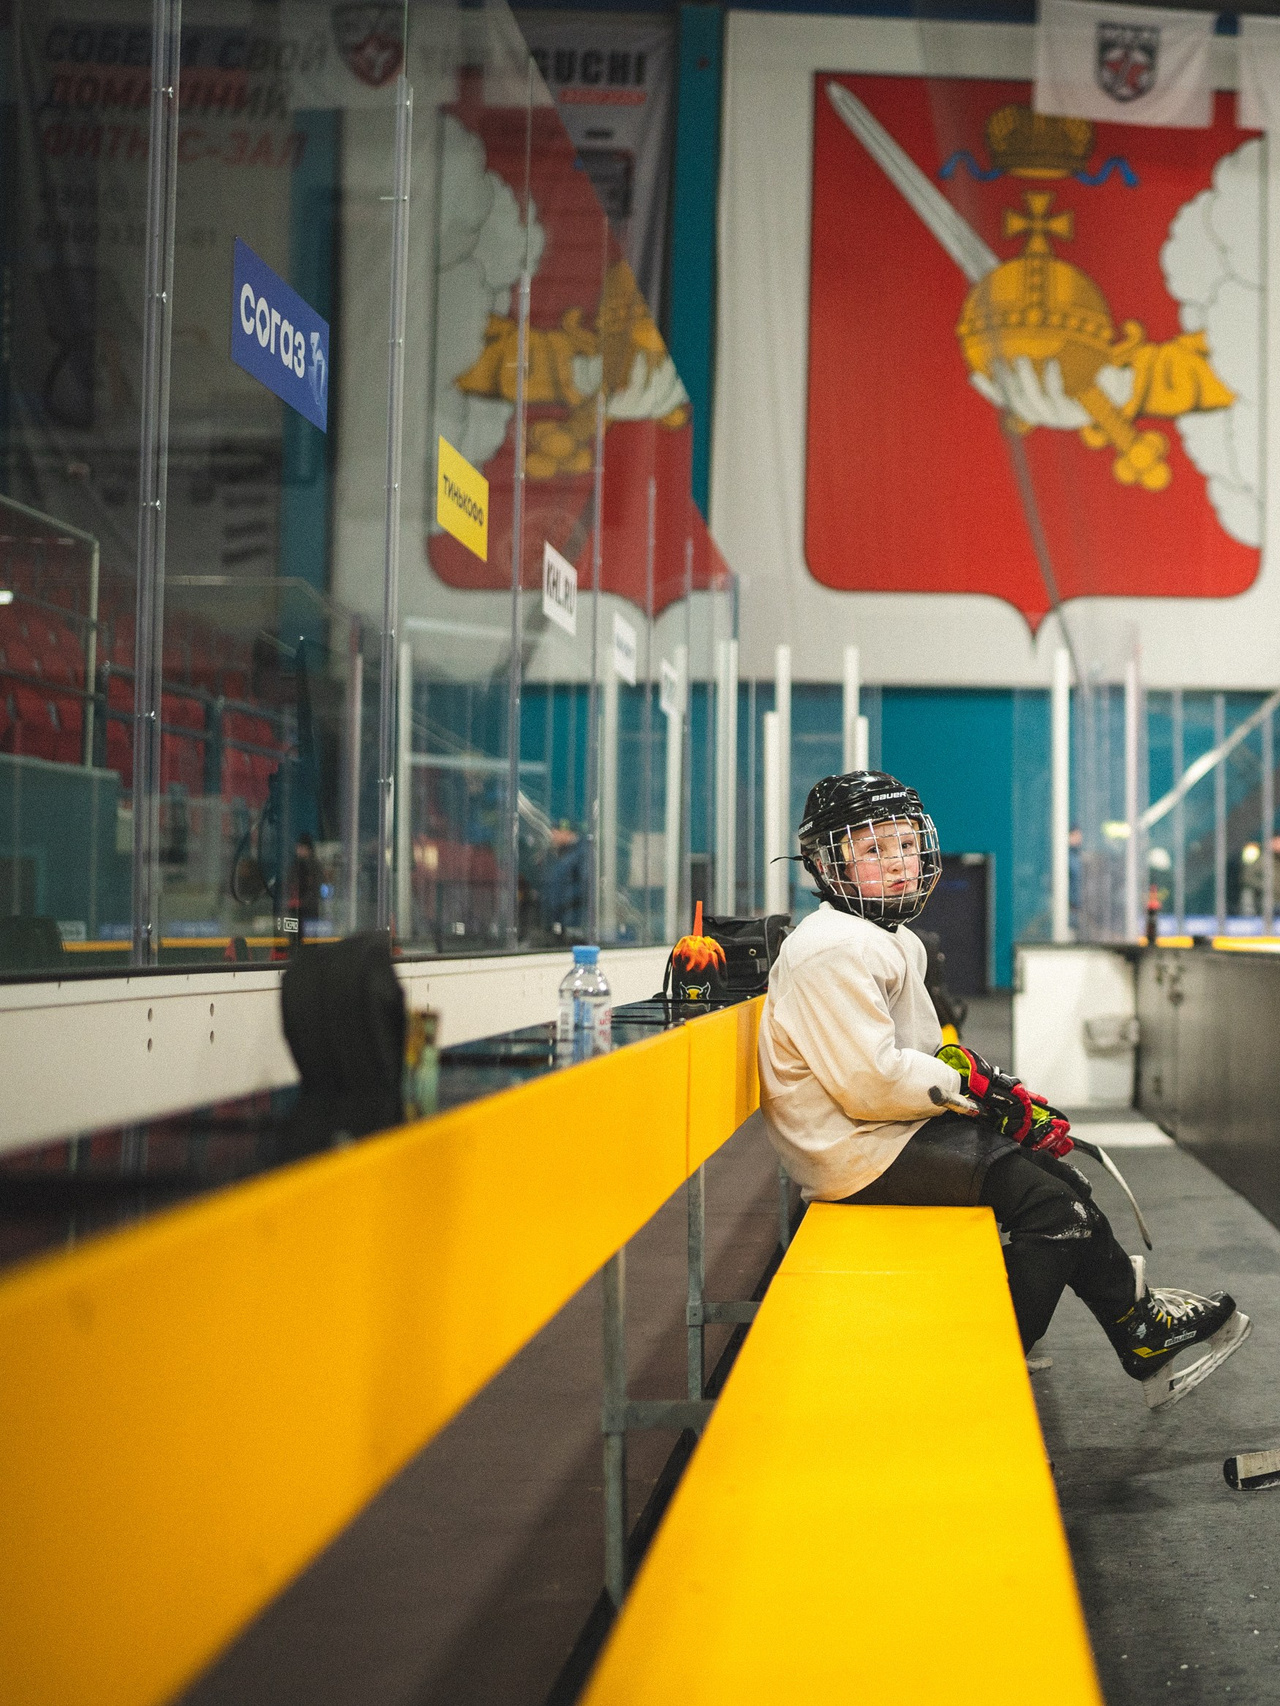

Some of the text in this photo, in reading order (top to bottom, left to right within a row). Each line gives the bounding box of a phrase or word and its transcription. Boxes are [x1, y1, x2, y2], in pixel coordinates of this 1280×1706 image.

[45, 25, 200, 67] СОБЕИ
[42, 124, 309, 168] ФИТНС-ЗАЛ
[871, 791, 907, 802] BAUER
